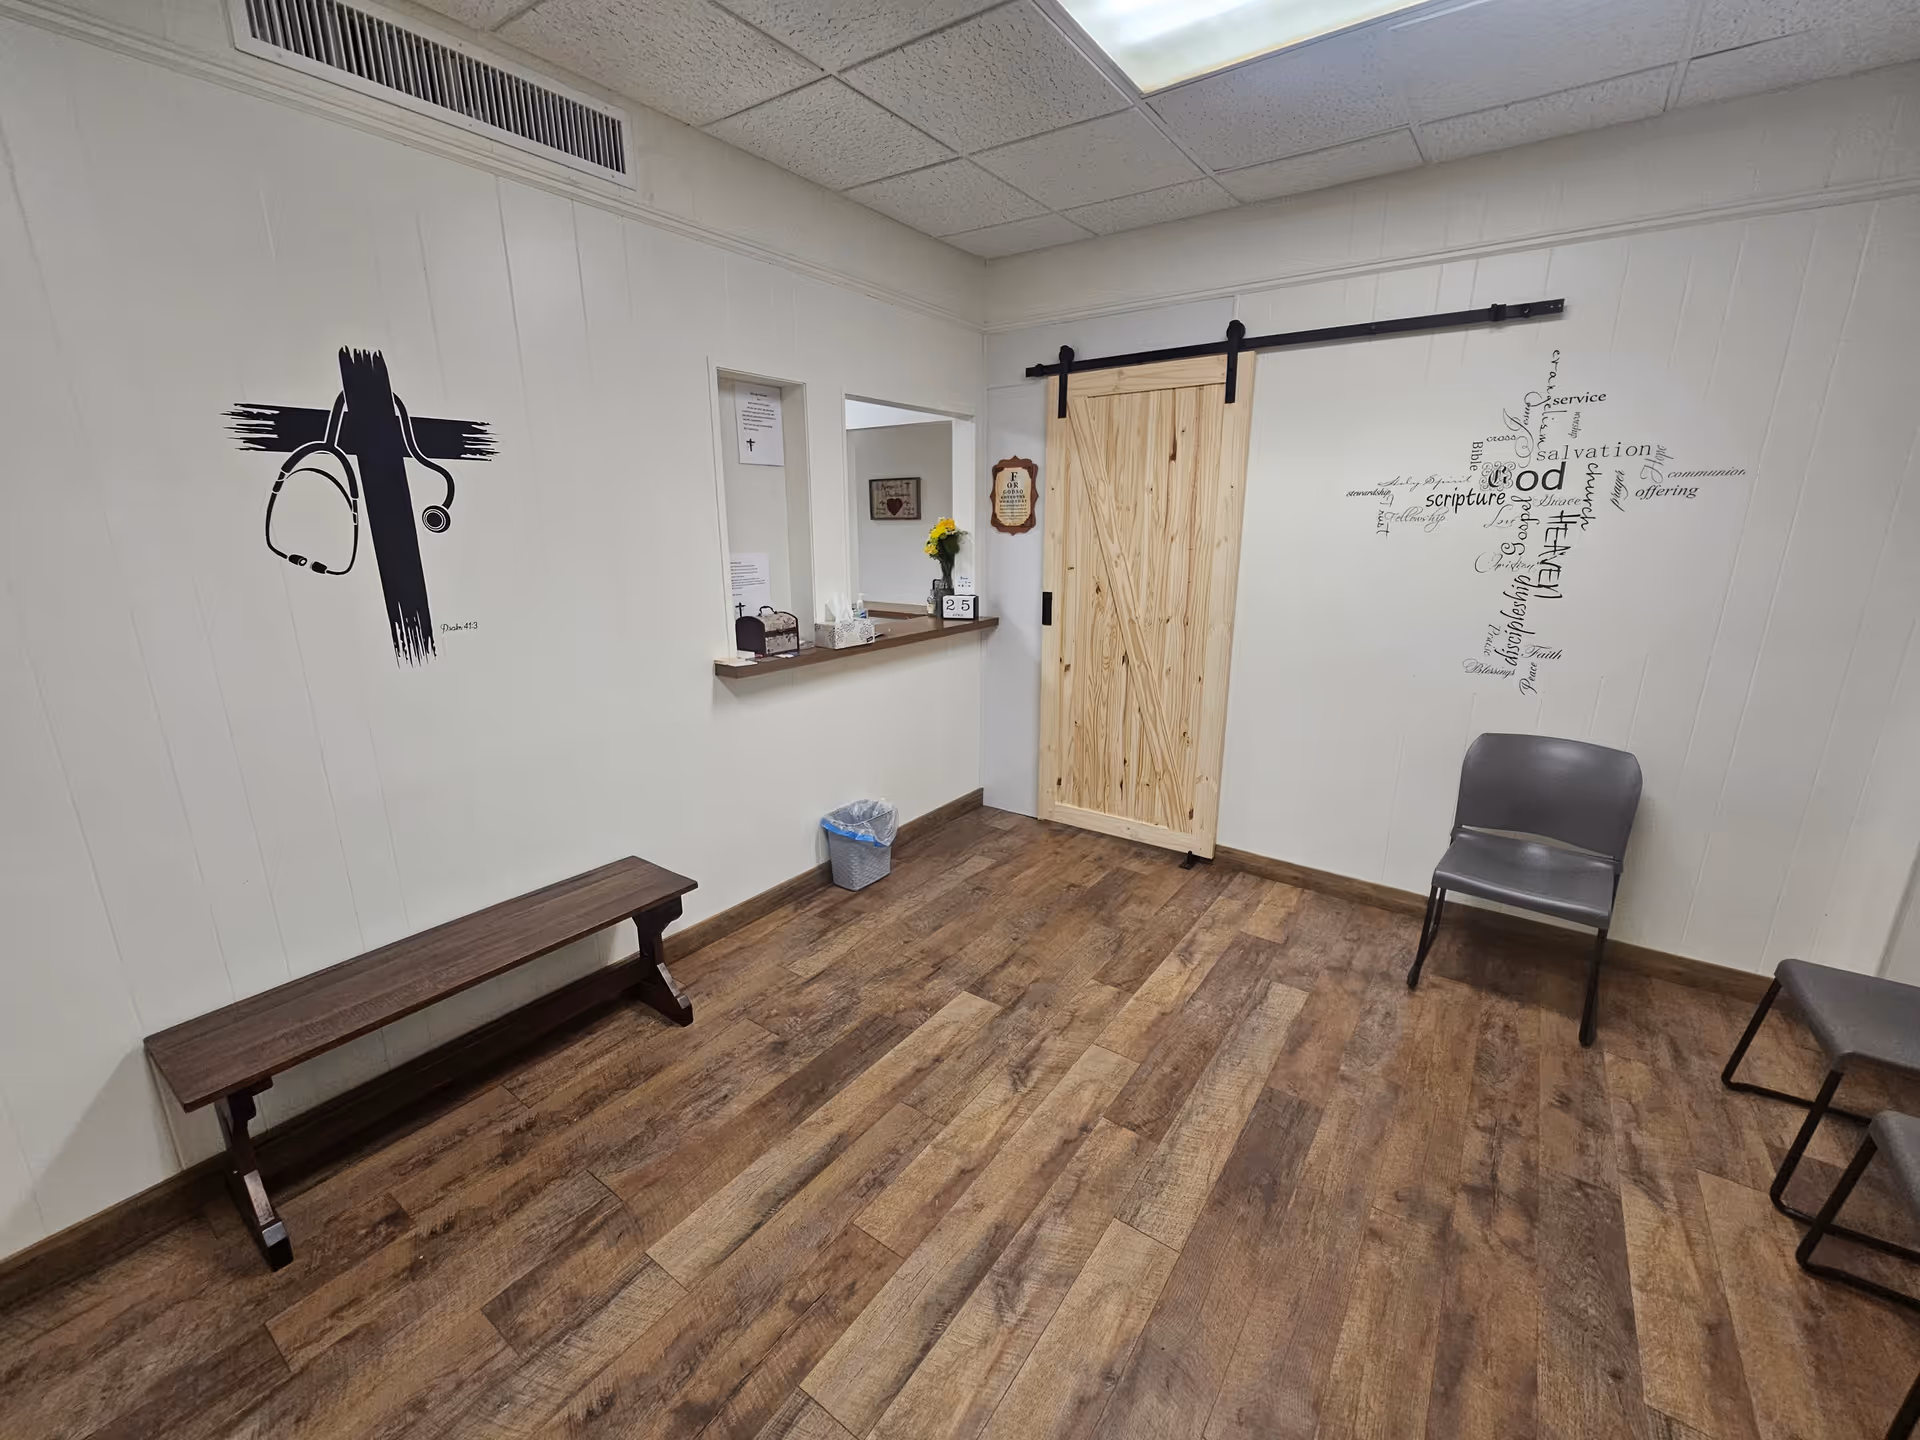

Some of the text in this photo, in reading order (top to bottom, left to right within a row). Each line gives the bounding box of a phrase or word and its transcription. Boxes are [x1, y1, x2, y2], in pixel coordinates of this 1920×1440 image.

[1537, 349, 1567, 451] evangelism
[1552, 391, 1607, 406] service
[1486, 434, 1516, 442] cross
[1567, 411, 1582, 439] worship
[1470, 441, 1484, 471] Bible
[1536, 442, 1651, 461] salvation
[1640, 444, 1674, 484] Hope
[1010, 471, 1018, 482] F
[1377, 474, 1472, 492] Holy Spirit
[1479, 460, 1567, 491] God
[1667, 466, 1747, 478] communion
[1346, 488, 1391, 498] stewardship
[1425, 487, 1506, 514] scripture
[1533, 494, 1581, 507] Grace
[1580, 463, 1603, 532] church
[1610, 469, 1629, 512] prayer
[1635, 485, 1700, 500] offering
[1376, 494, 1395, 539] Trust
[1384, 506, 1449, 533] Fellowship
[1501, 495, 1540, 556] Gospel
[440, 621, 479, 634] Psalm 41:3
[1494, 575, 1543, 667] discipleship
[1483, 624, 1501, 656] Praise
[1521, 645, 1563, 660] Faith
[1462, 658, 1516, 680] Blessings
[1519, 662, 1538, 695] Peace
